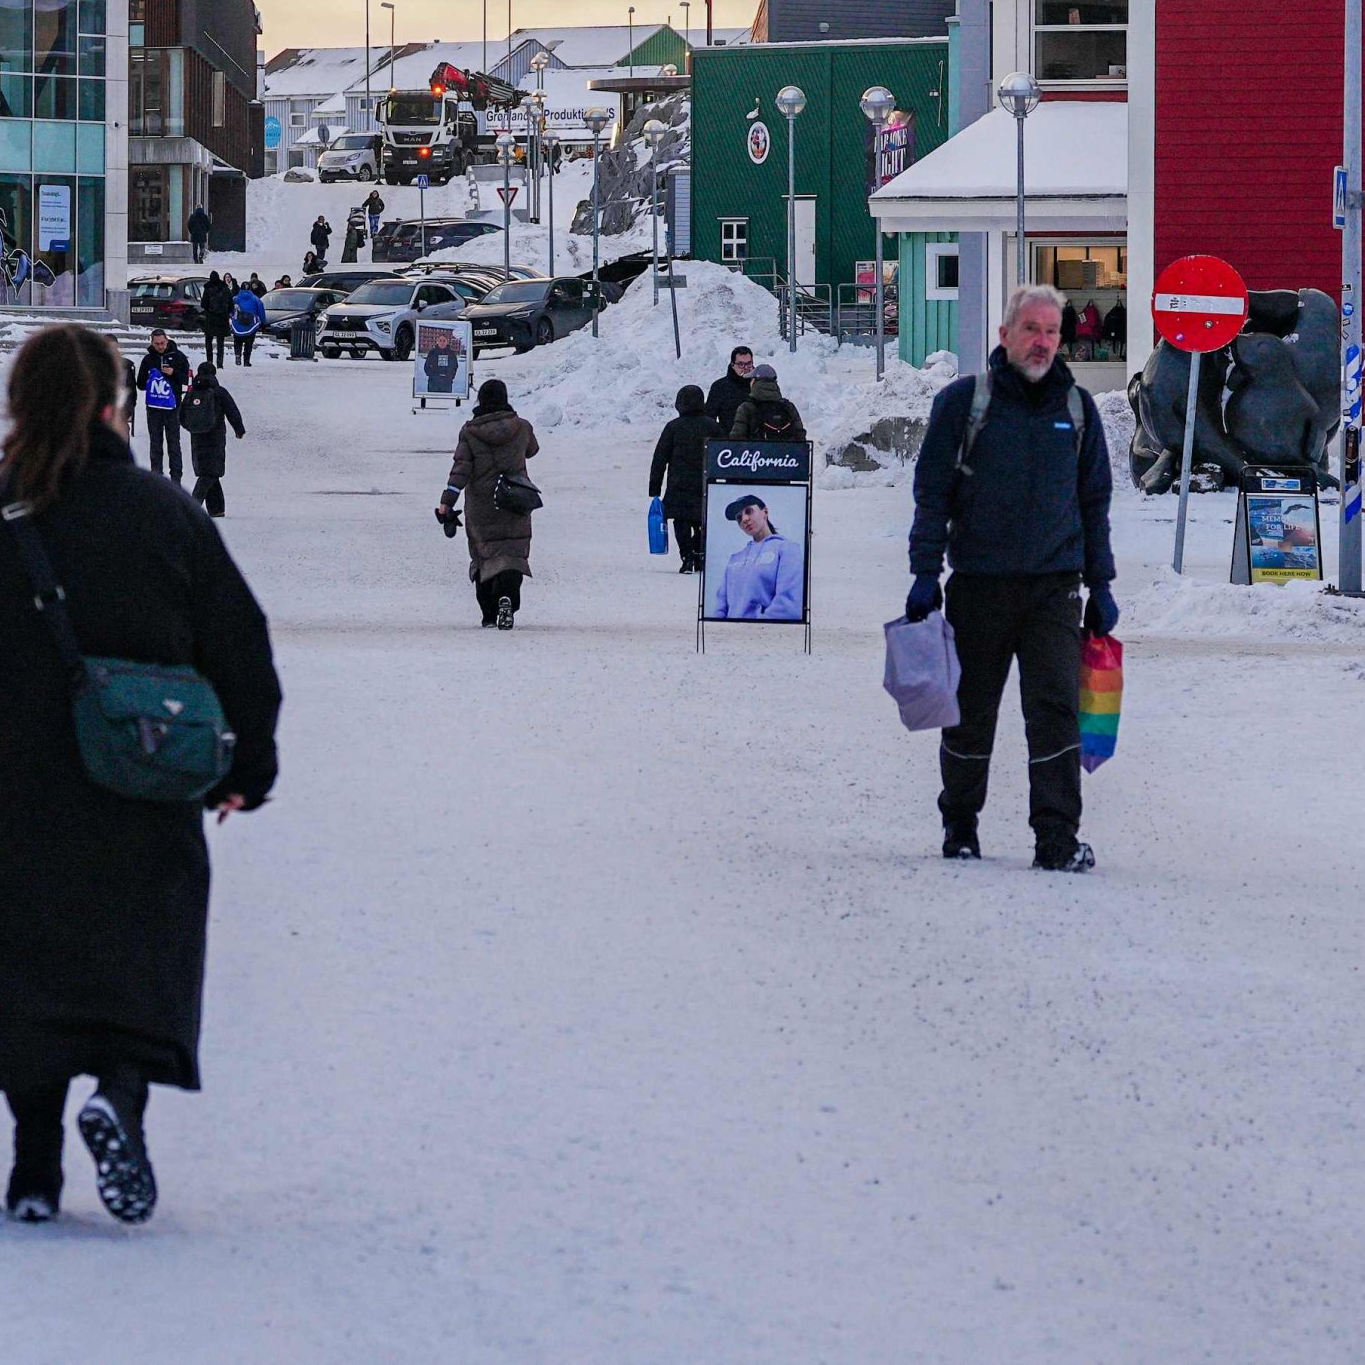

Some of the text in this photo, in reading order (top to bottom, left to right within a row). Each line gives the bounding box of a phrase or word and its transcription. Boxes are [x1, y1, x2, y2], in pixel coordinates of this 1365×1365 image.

[486, 110, 531, 122] Grønland
[881, 147, 907, 176] IGHT
[150, 380, 170, 395] NC
[717, 449, 799, 472] California
